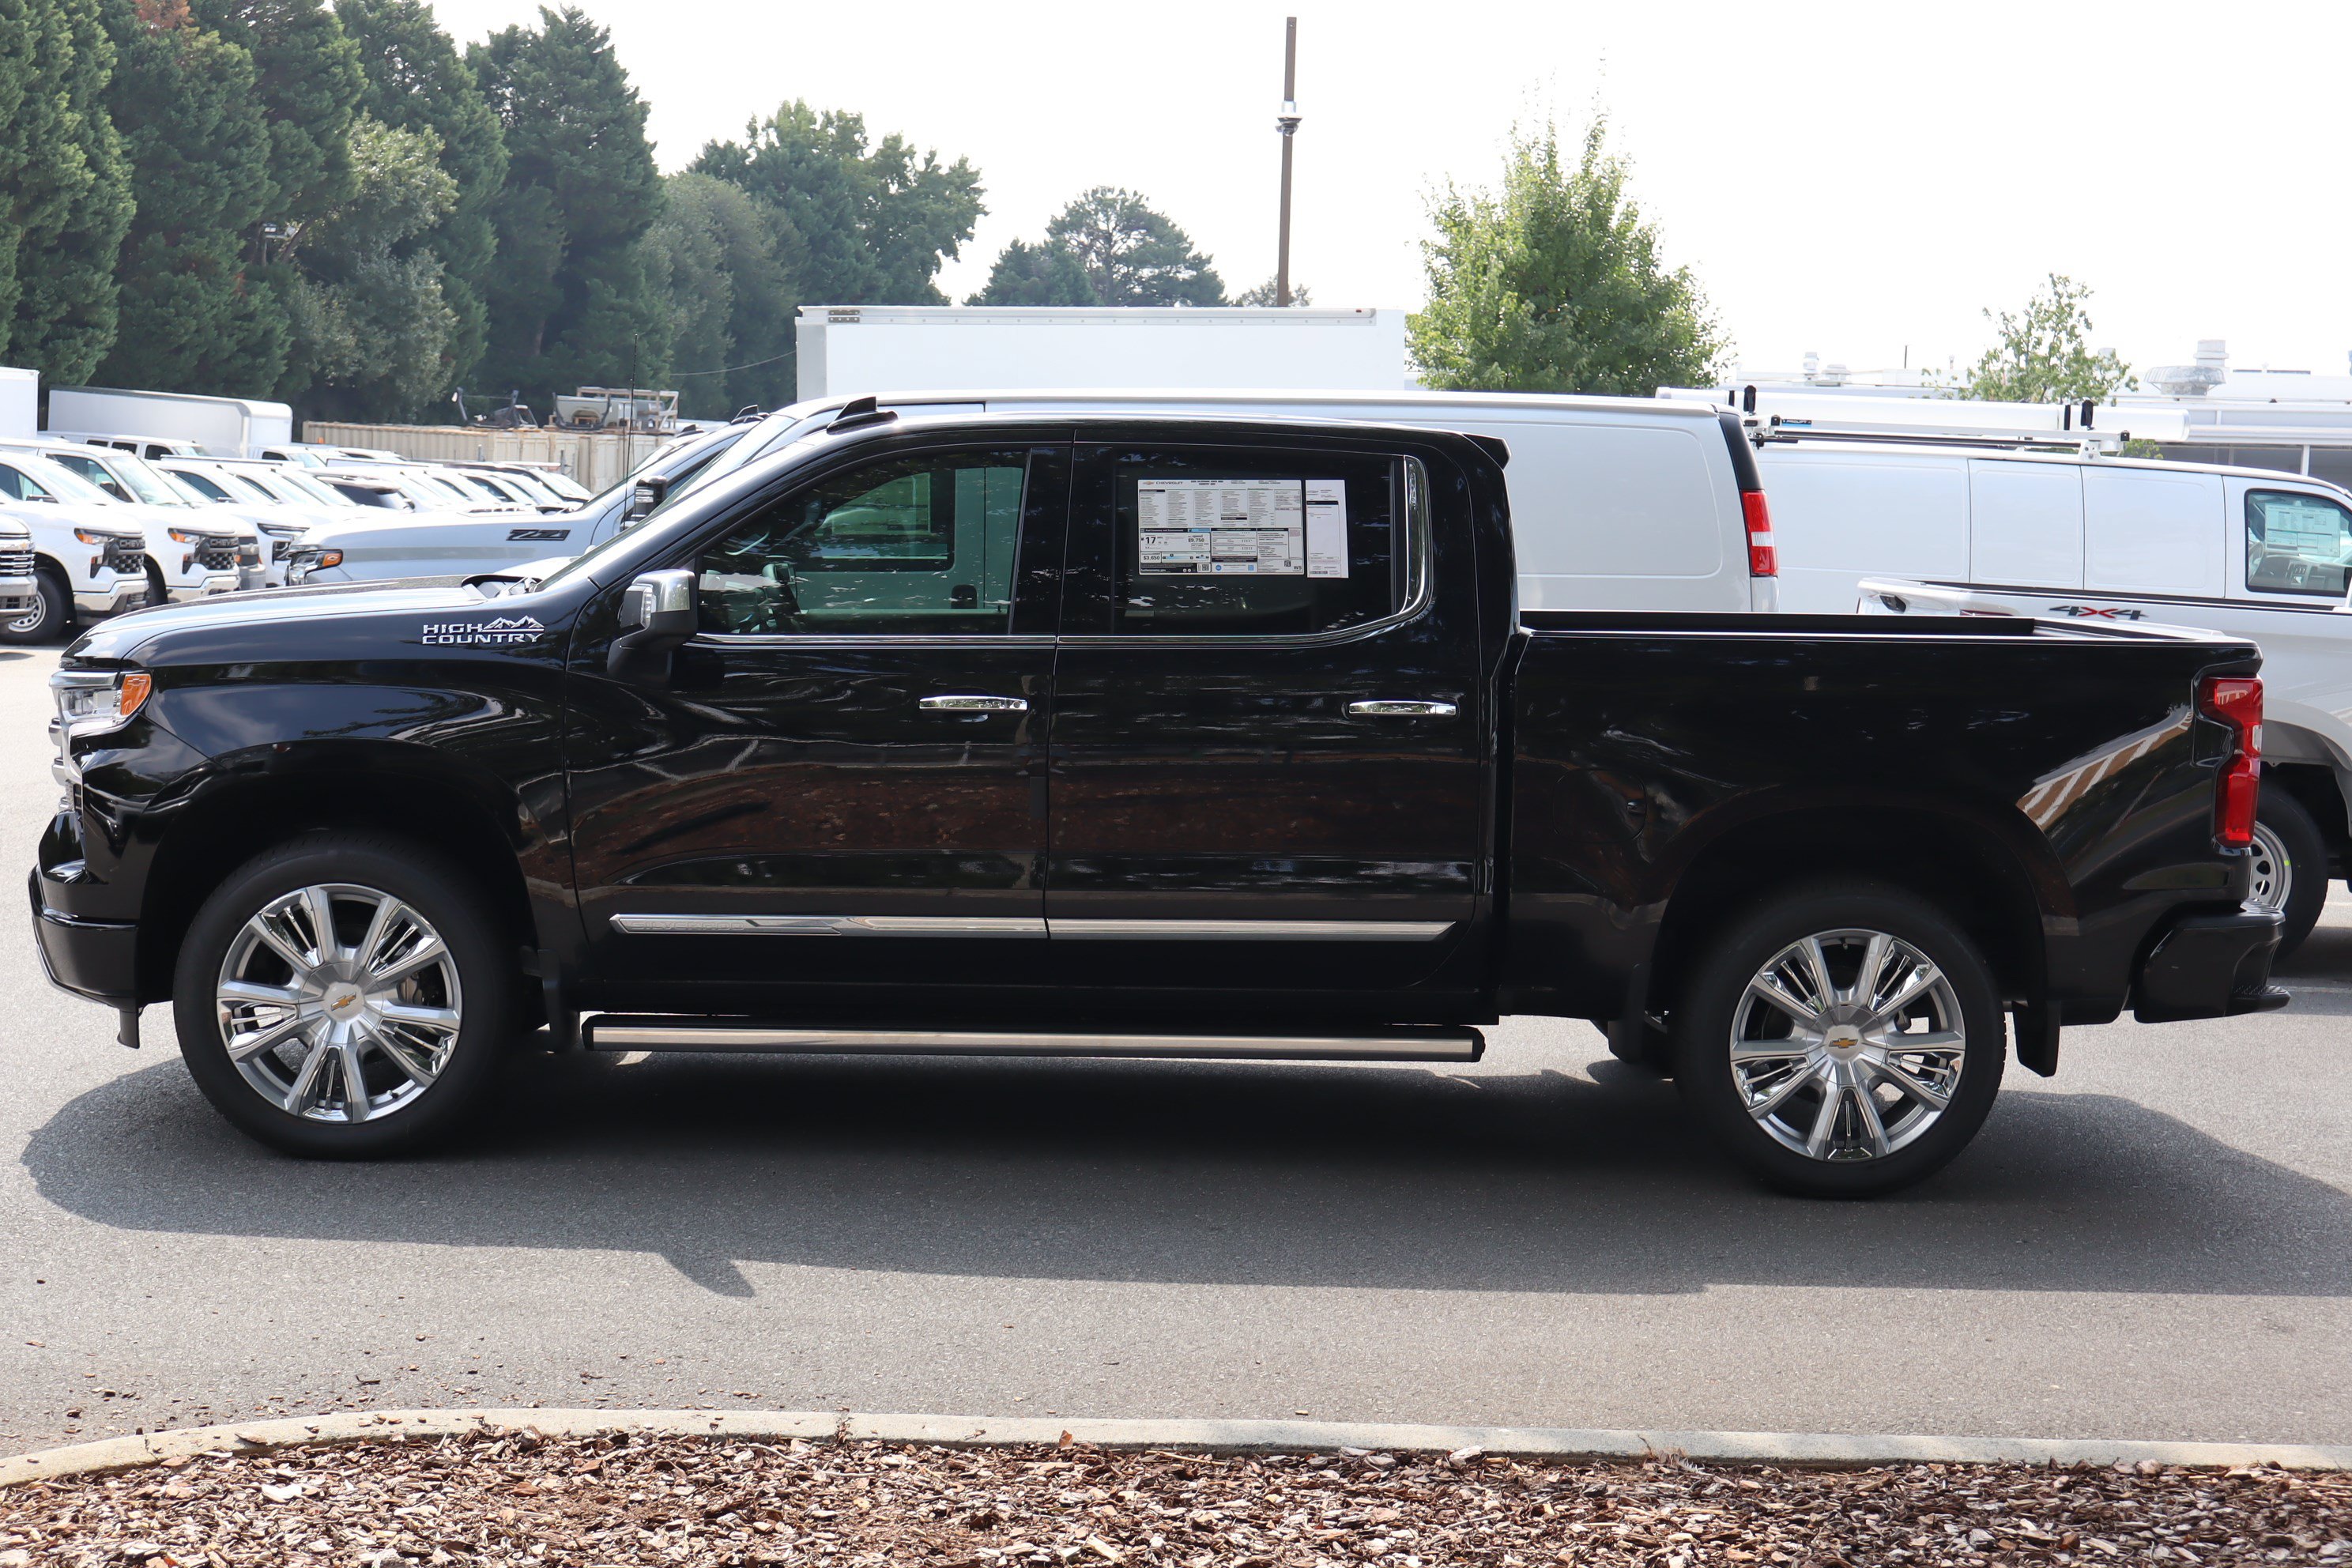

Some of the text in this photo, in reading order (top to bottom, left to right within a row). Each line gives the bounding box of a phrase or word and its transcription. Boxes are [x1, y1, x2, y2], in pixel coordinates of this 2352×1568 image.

[505, 529, 571, 541] Z71
[423, 623, 484, 635] HIGH
[422, 633, 544, 645] COUNTRY
